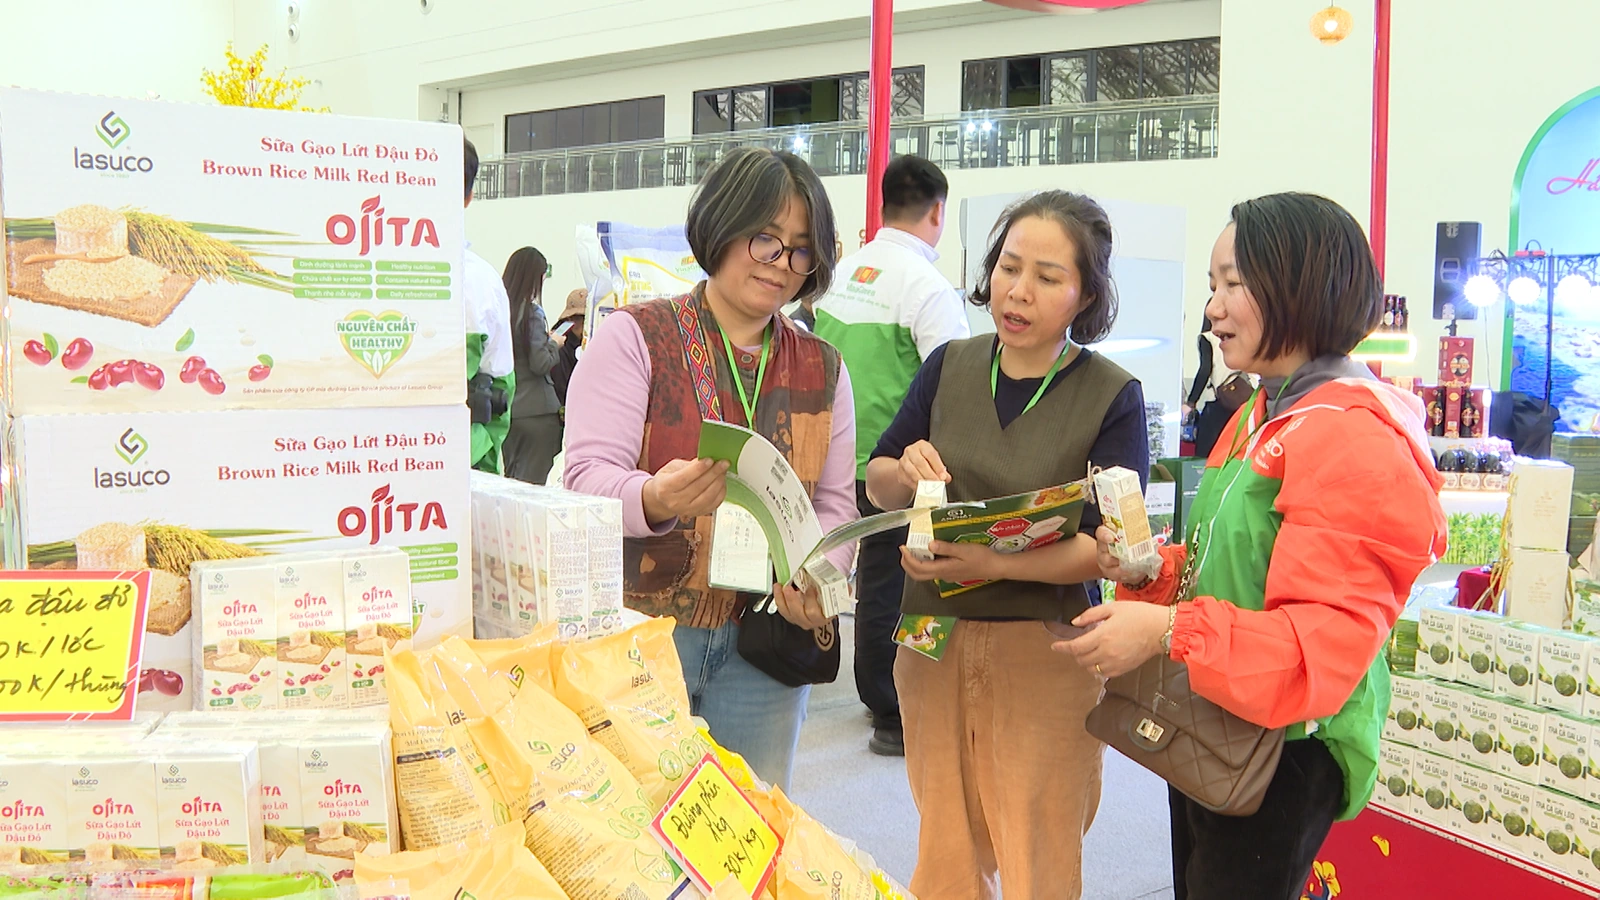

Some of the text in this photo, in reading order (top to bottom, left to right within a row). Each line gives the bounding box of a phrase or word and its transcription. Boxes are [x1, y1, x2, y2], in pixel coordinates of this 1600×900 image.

[74, 146, 153, 172] lasuco
[261, 137, 438, 163] Sữa Gạo Lứt Đậu Đỏ
[203, 160, 436, 187] Brown Rice Milk Red Bean
[337, 317, 416, 332] NGUYÊN CHẤT
[352, 338, 402, 348] HEALTHY
[274, 432, 446, 453] Sữa Gạo Lứt Đậu Đỏ
[95, 468, 170, 488] lasuco
[218, 458, 444, 480] Brown Rice Milk Red Bean
[0, 822, 12, 831] ữa
